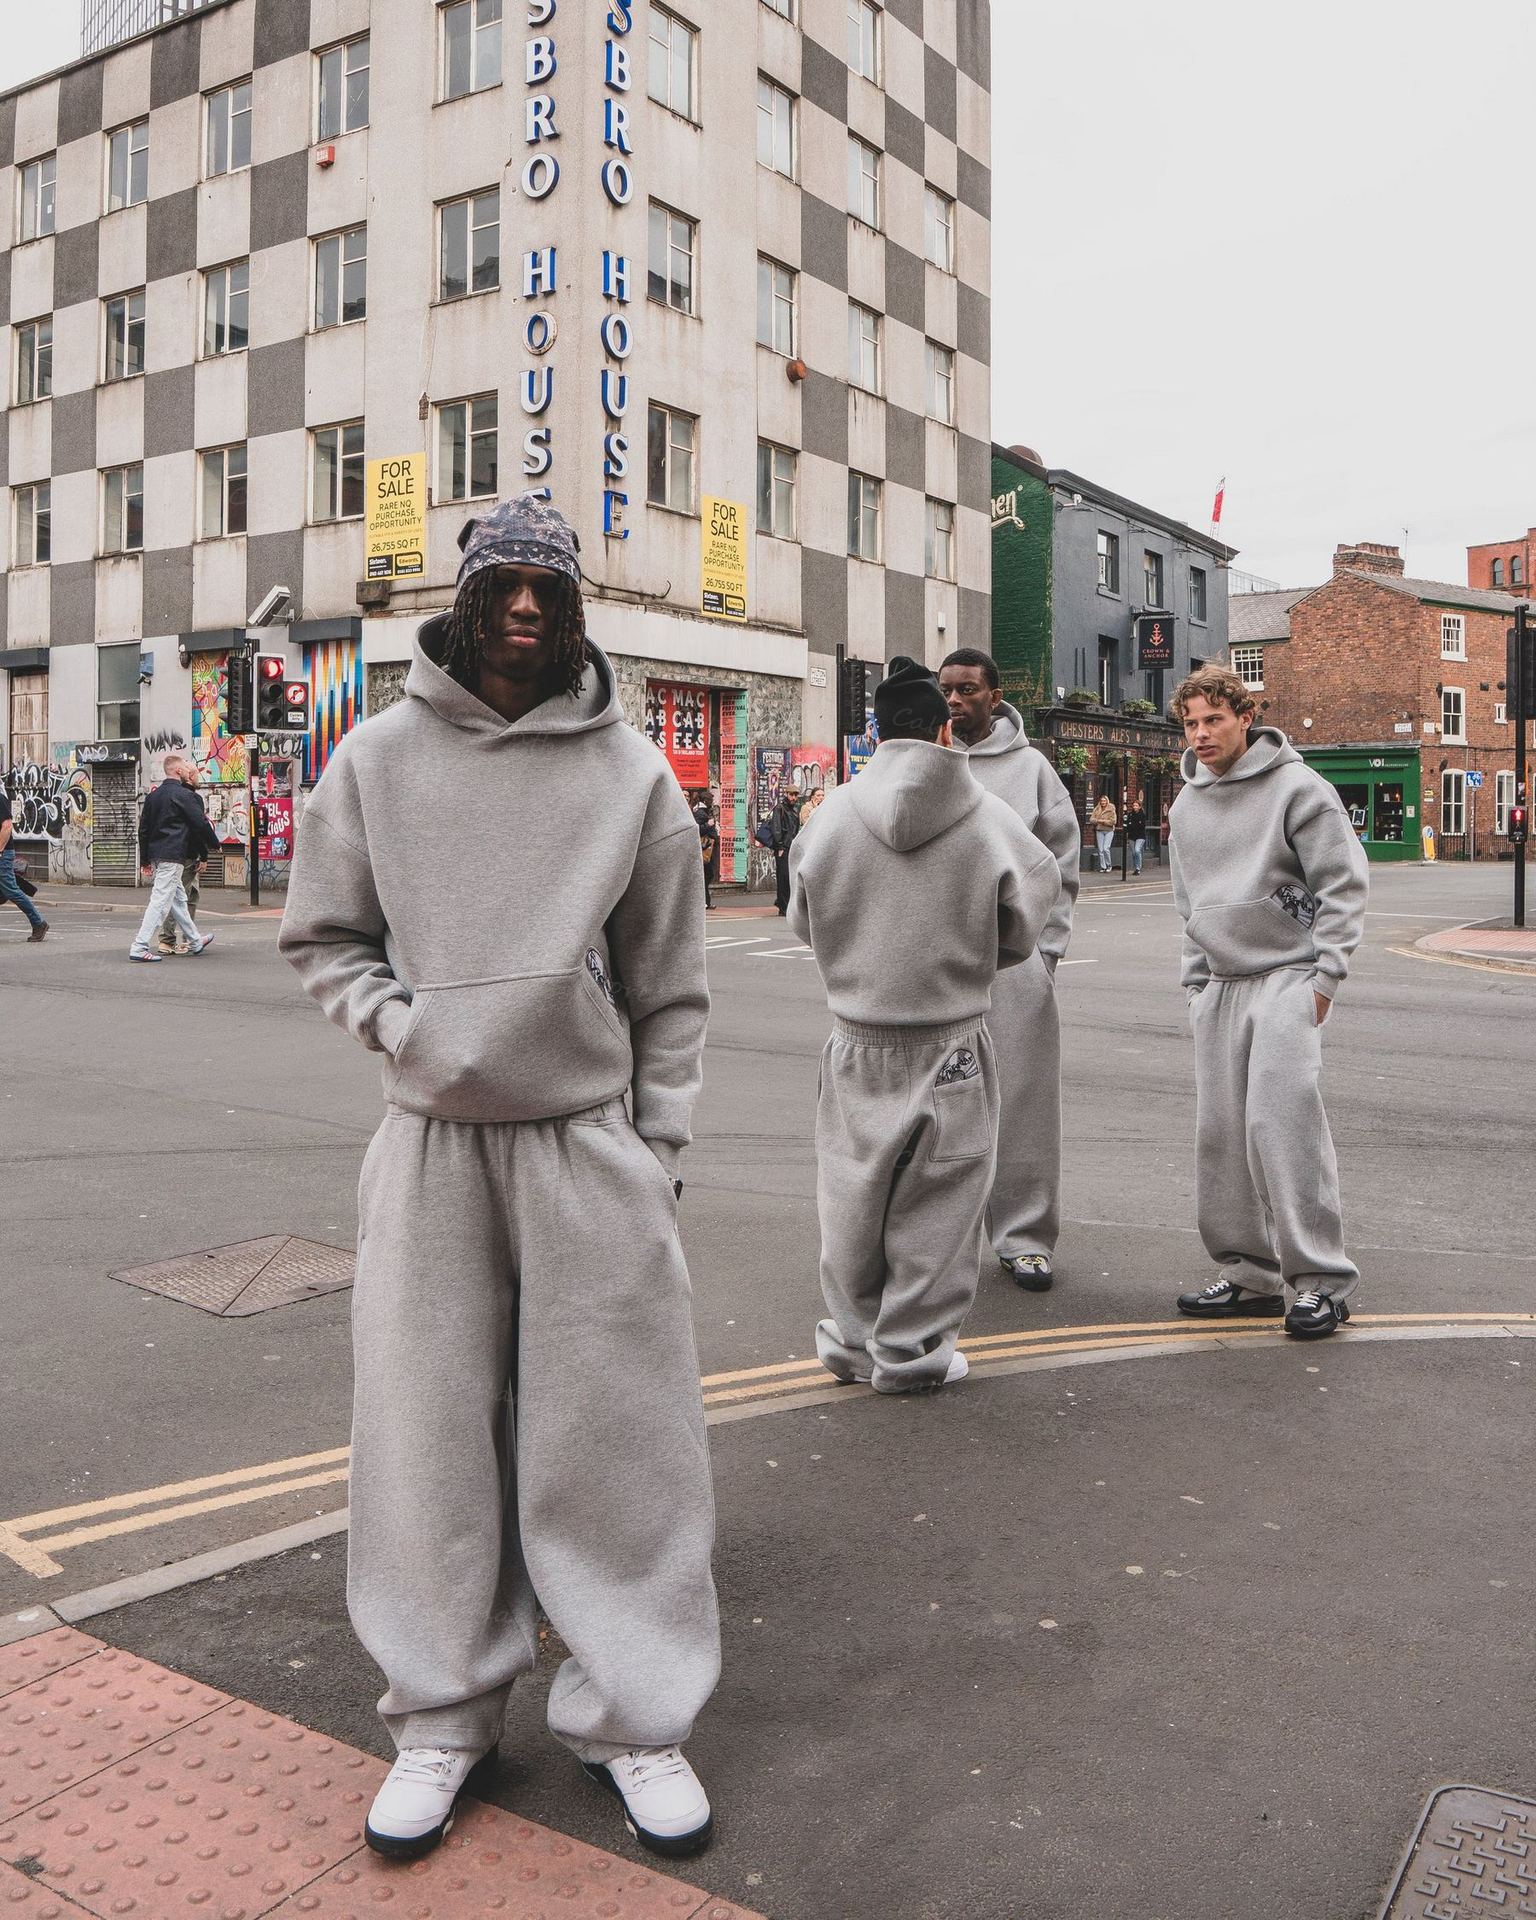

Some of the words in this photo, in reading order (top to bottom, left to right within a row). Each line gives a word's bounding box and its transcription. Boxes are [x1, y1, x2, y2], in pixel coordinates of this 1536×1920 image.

[519, 246, 558, 500] HOUS
[600, 249, 634, 540] HOUSE
[381, 460, 411, 480] FOR
[377, 477, 415, 499] SALE
[375, 508, 415, 521] PURCHASE
[379, 502, 399, 512] RARE
[713, 502, 737, 522] FOR
[369, 516, 422, 531] OPPORTUNITY
[710, 519, 739, 541] SALE
[410, 537, 420, 548] FT
[711, 540, 727, 550] RARE
[703, 556, 745, 572] OPPORTUNITY
[709, 548, 740, 563] PURCHASE
[672, 689, 705, 709] MAC
[672, 710, 705, 729] CAB
[672, 731, 705, 750] EES
[1060, 720, 1104, 741] CHESTERS
[1111, 727, 1131, 744] ALES
